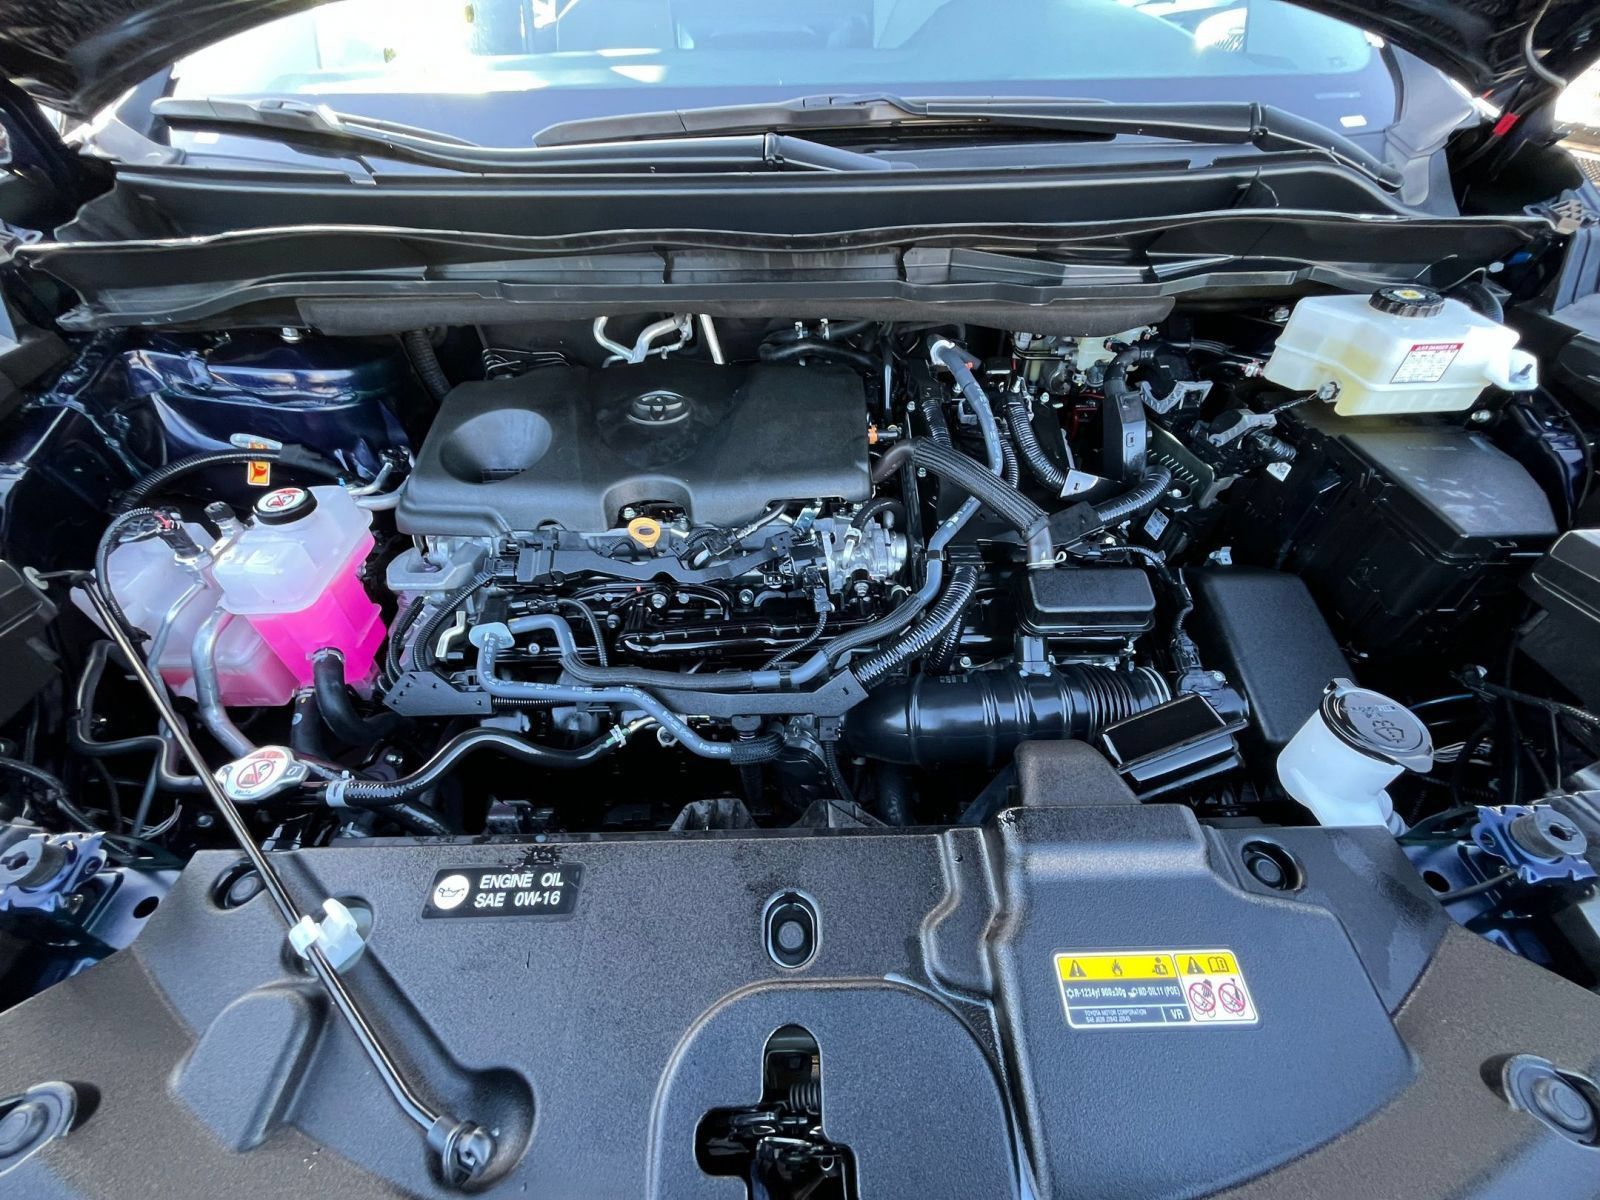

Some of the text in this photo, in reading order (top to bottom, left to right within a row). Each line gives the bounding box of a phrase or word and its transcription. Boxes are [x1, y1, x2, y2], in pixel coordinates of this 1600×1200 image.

[479, 872, 564, 889] ENGINE OIL
[474, 891, 561, 908] SAE 0W-16
[1165, 985, 1181, 997] (POE)
[1171, 1008, 1185, 1020] VR
